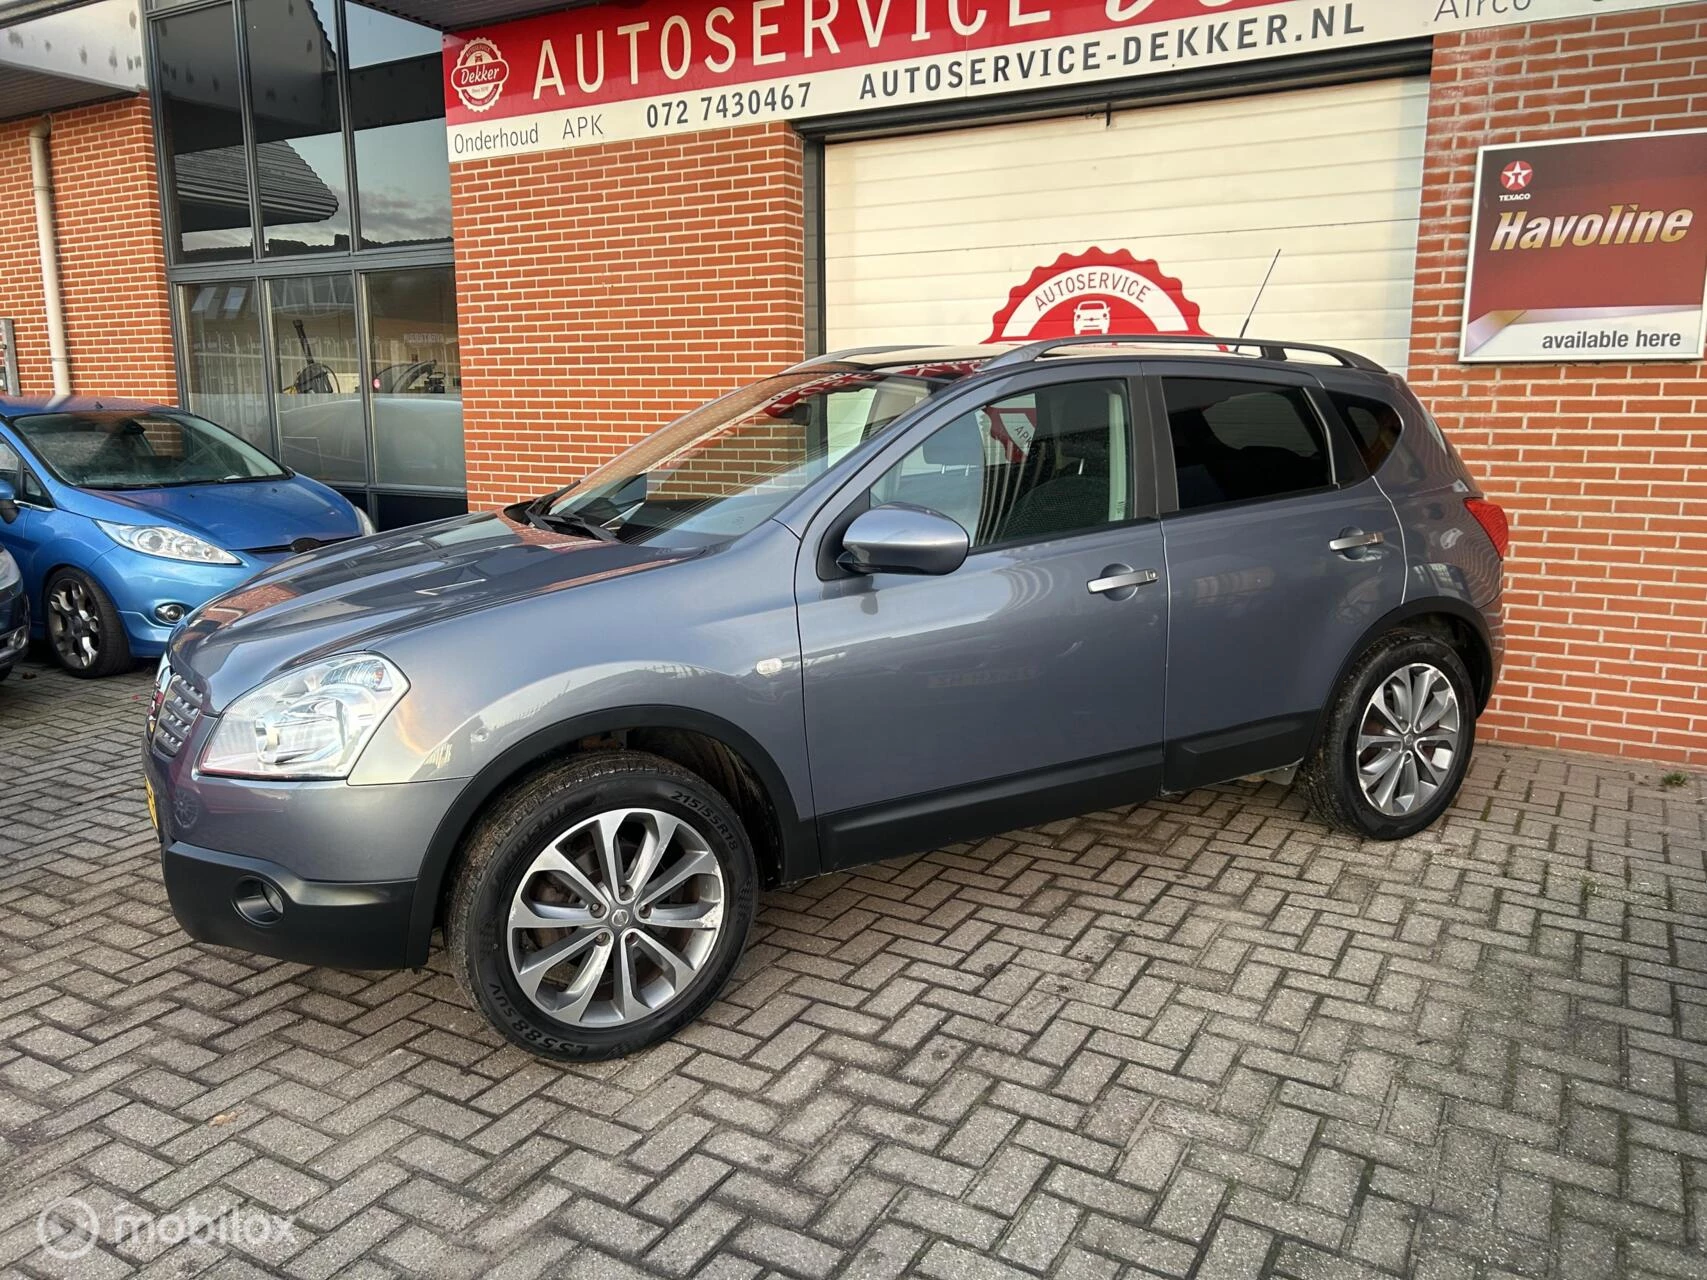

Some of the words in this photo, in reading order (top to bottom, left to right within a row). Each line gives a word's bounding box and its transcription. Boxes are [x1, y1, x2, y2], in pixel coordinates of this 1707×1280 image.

[454, 122, 539, 154] Onderhoud
[562, 113, 604, 140] APK
[646, 100, 689, 128] 072
[700, 82, 811, 121] 7430467
[859, 3, 1365, 100] AUTOSERVICE-DEKKER.NL
[461, 65, 500, 85] Dekker
[1499, 193, 1531, 202] TEXACO
[1489, 203, 1694, 251] Havoline
[1034, 272, 1151, 311] AUTOSERVICE
[1542, 333, 1629, 349] available
[1635, 330, 1682, 348] here
[671, 790, 738, 850] 215/55R18
